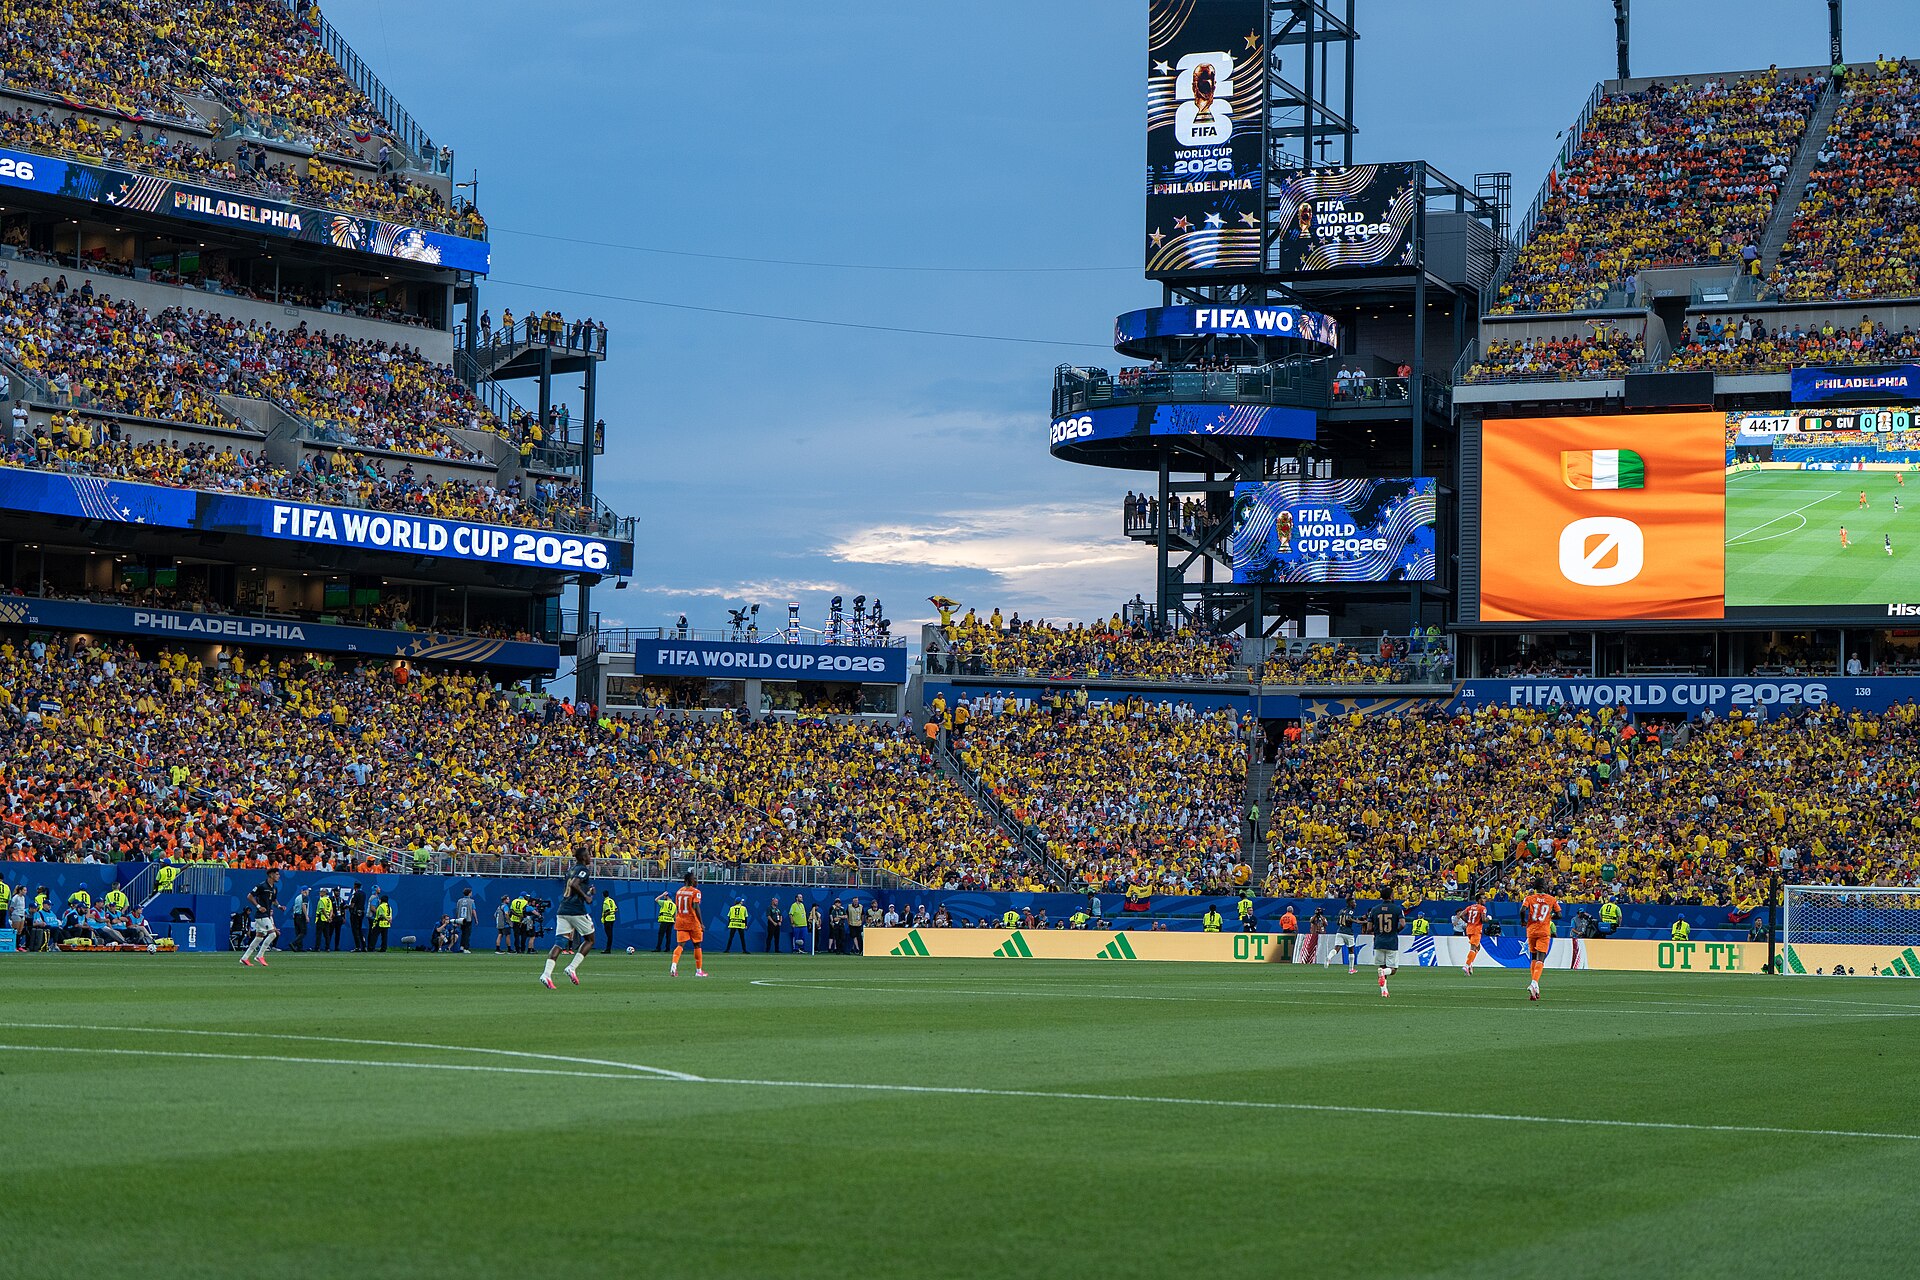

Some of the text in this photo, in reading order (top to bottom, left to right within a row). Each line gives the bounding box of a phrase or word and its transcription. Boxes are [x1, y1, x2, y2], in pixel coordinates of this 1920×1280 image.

[1191, 126, 1217, 138] FIFA
[1174, 147, 1233, 160] WORLD CUP
[1174, 157, 1233, 174] 2026
[1153, 178, 1252, 195] PHILADELPHIA
[174, 191, 302, 231] PHILADELPHIA
[1316, 200, 1345, 213] FIFA
[1316, 212, 1365, 225] WORLD
[1316, 222, 1391, 238] CUP 2026
[1195, 308, 1293, 332] FIFA WO
[1815, 376, 1908, 389] PHILADELPHIA
[1052, 415, 1093, 445] 2026
[1749, 419, 1790, 432] 44:17
[1865, 417, 1872, 428] 0
[1897, 416, 1905, 428] 0
[1298, 509, 1332, 522] FIFA
[273, 505, 608, 569] FIFA WORLD CUP 2026
[1298, 523, 1355, 537] WORLD
[1298, 538, 1388, 552] CUP 2026
[134, 612, 305, 641] PHILADELPHIA
[657, 649, 885, 672] FIFA WORLD CUP 2026
[1462, 689, 1475, 697] 131
[1510, 683, 1828, 706] FIFA WORLD CUP 2026
[1855, 687, 1871, 696] 130
[678, 895, 689, 914] 11
[1532, 903, 1550, 921] 19
[1378, 913, 1393, 933] 15
[1468, 910, 1479, 924] 17
[1234, 935, 1268, 960] OT
[1658, 943, 1695, 969] OT
